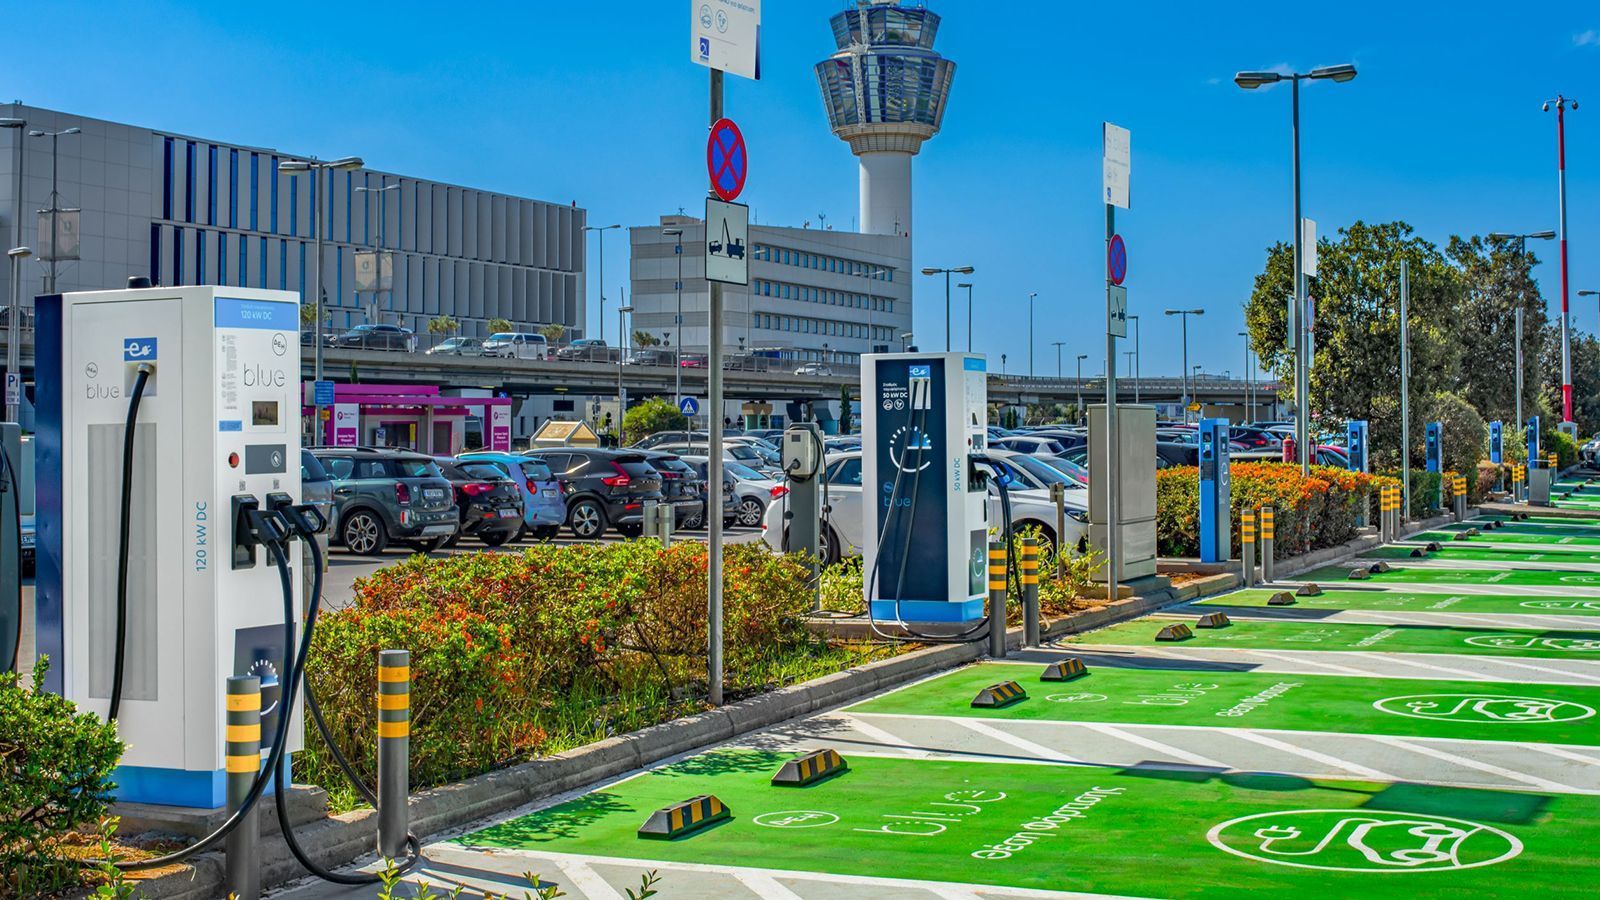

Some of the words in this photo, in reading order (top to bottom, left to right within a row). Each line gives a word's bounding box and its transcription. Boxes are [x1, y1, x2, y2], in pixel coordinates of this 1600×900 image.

[241, 310, 252, 319] 120
[252, 311, 262, 320] kW
[263, 312, 273, 321] DC
[244, 363, 285, 387] blue
[86, 383, 120, 399] blue
[954, 482, 961, 491] 50
[195, 501, 207, 521] DC
[884, 496, 911, 507] bue
[195, 524, 207, 545] kW
[195, 549, 207, 571] 120
[853, 790, 1007, 837] blue
[970, 832, 1057, 860] Θέση
